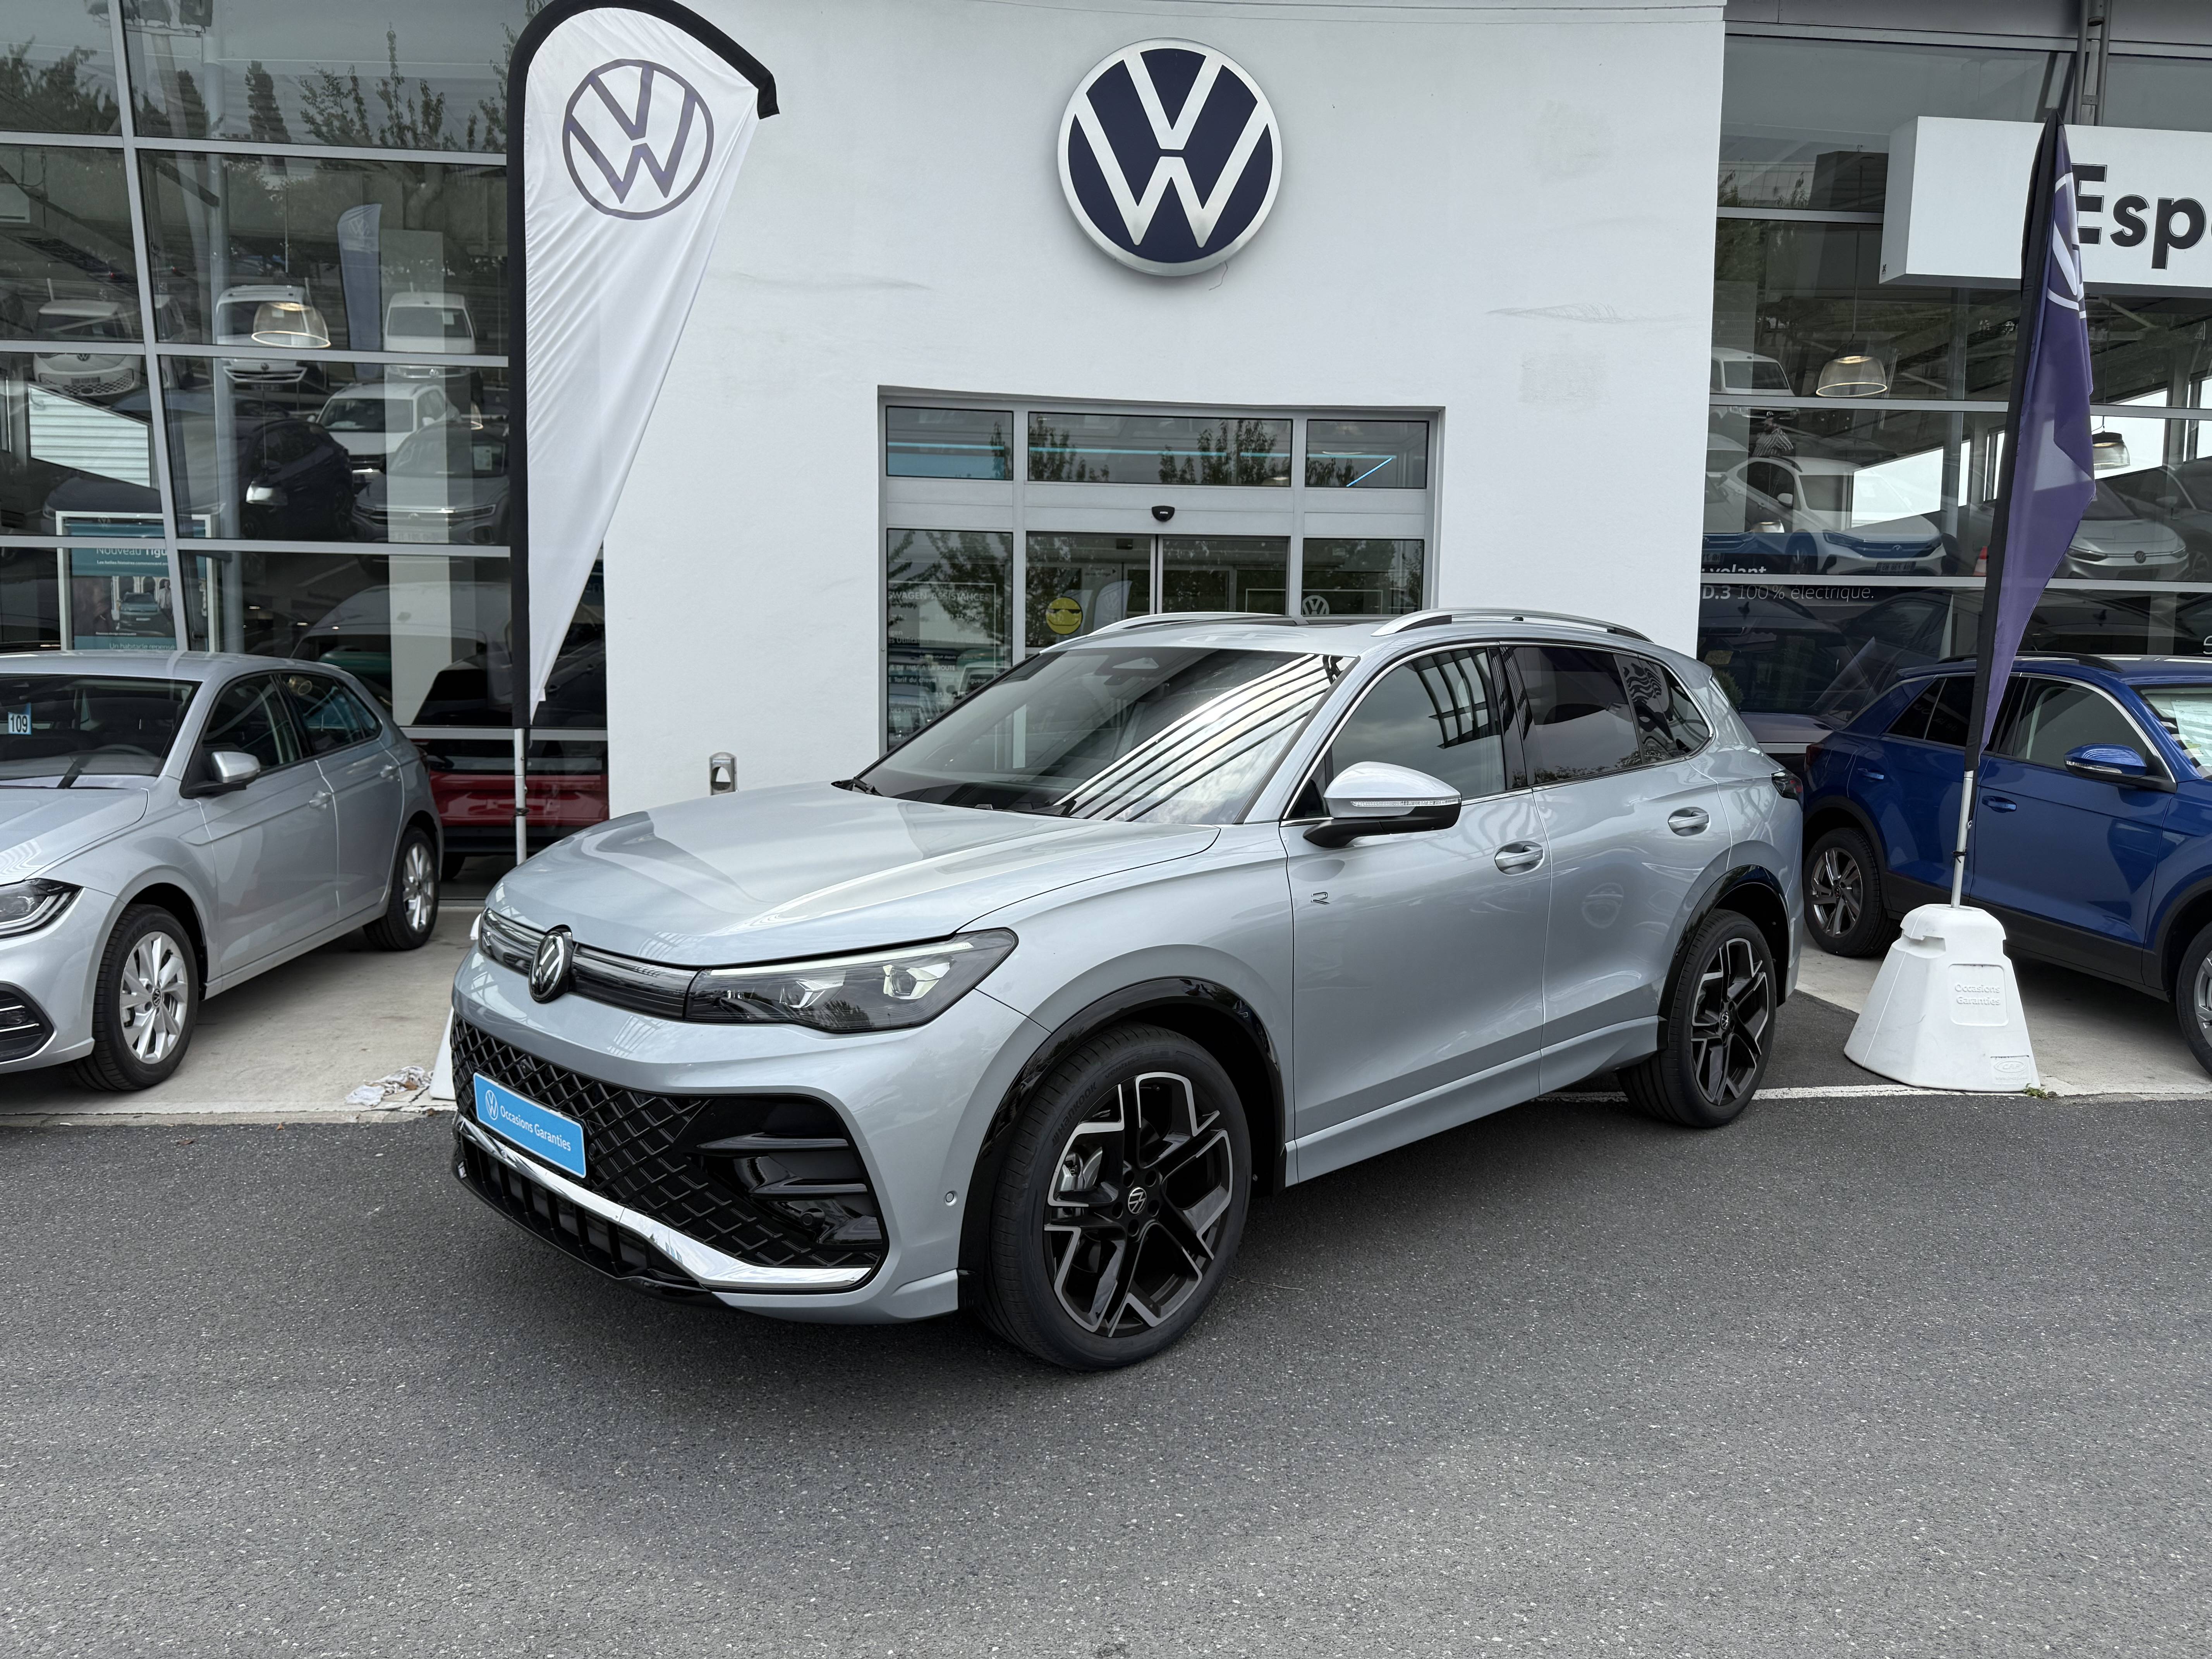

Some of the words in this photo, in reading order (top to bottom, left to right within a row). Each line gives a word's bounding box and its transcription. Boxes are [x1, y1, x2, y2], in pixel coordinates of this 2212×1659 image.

[2071, 163, 2212, 270] Esp
[10, 715, 27, 733] 109
[1955, 984, 2001, 994] Occasions
[1956, 997, 2001, 1006] Garanties
[500, 1104, 533, 1134] Occasions
[534, 1123, 572, 1152] Garanties
